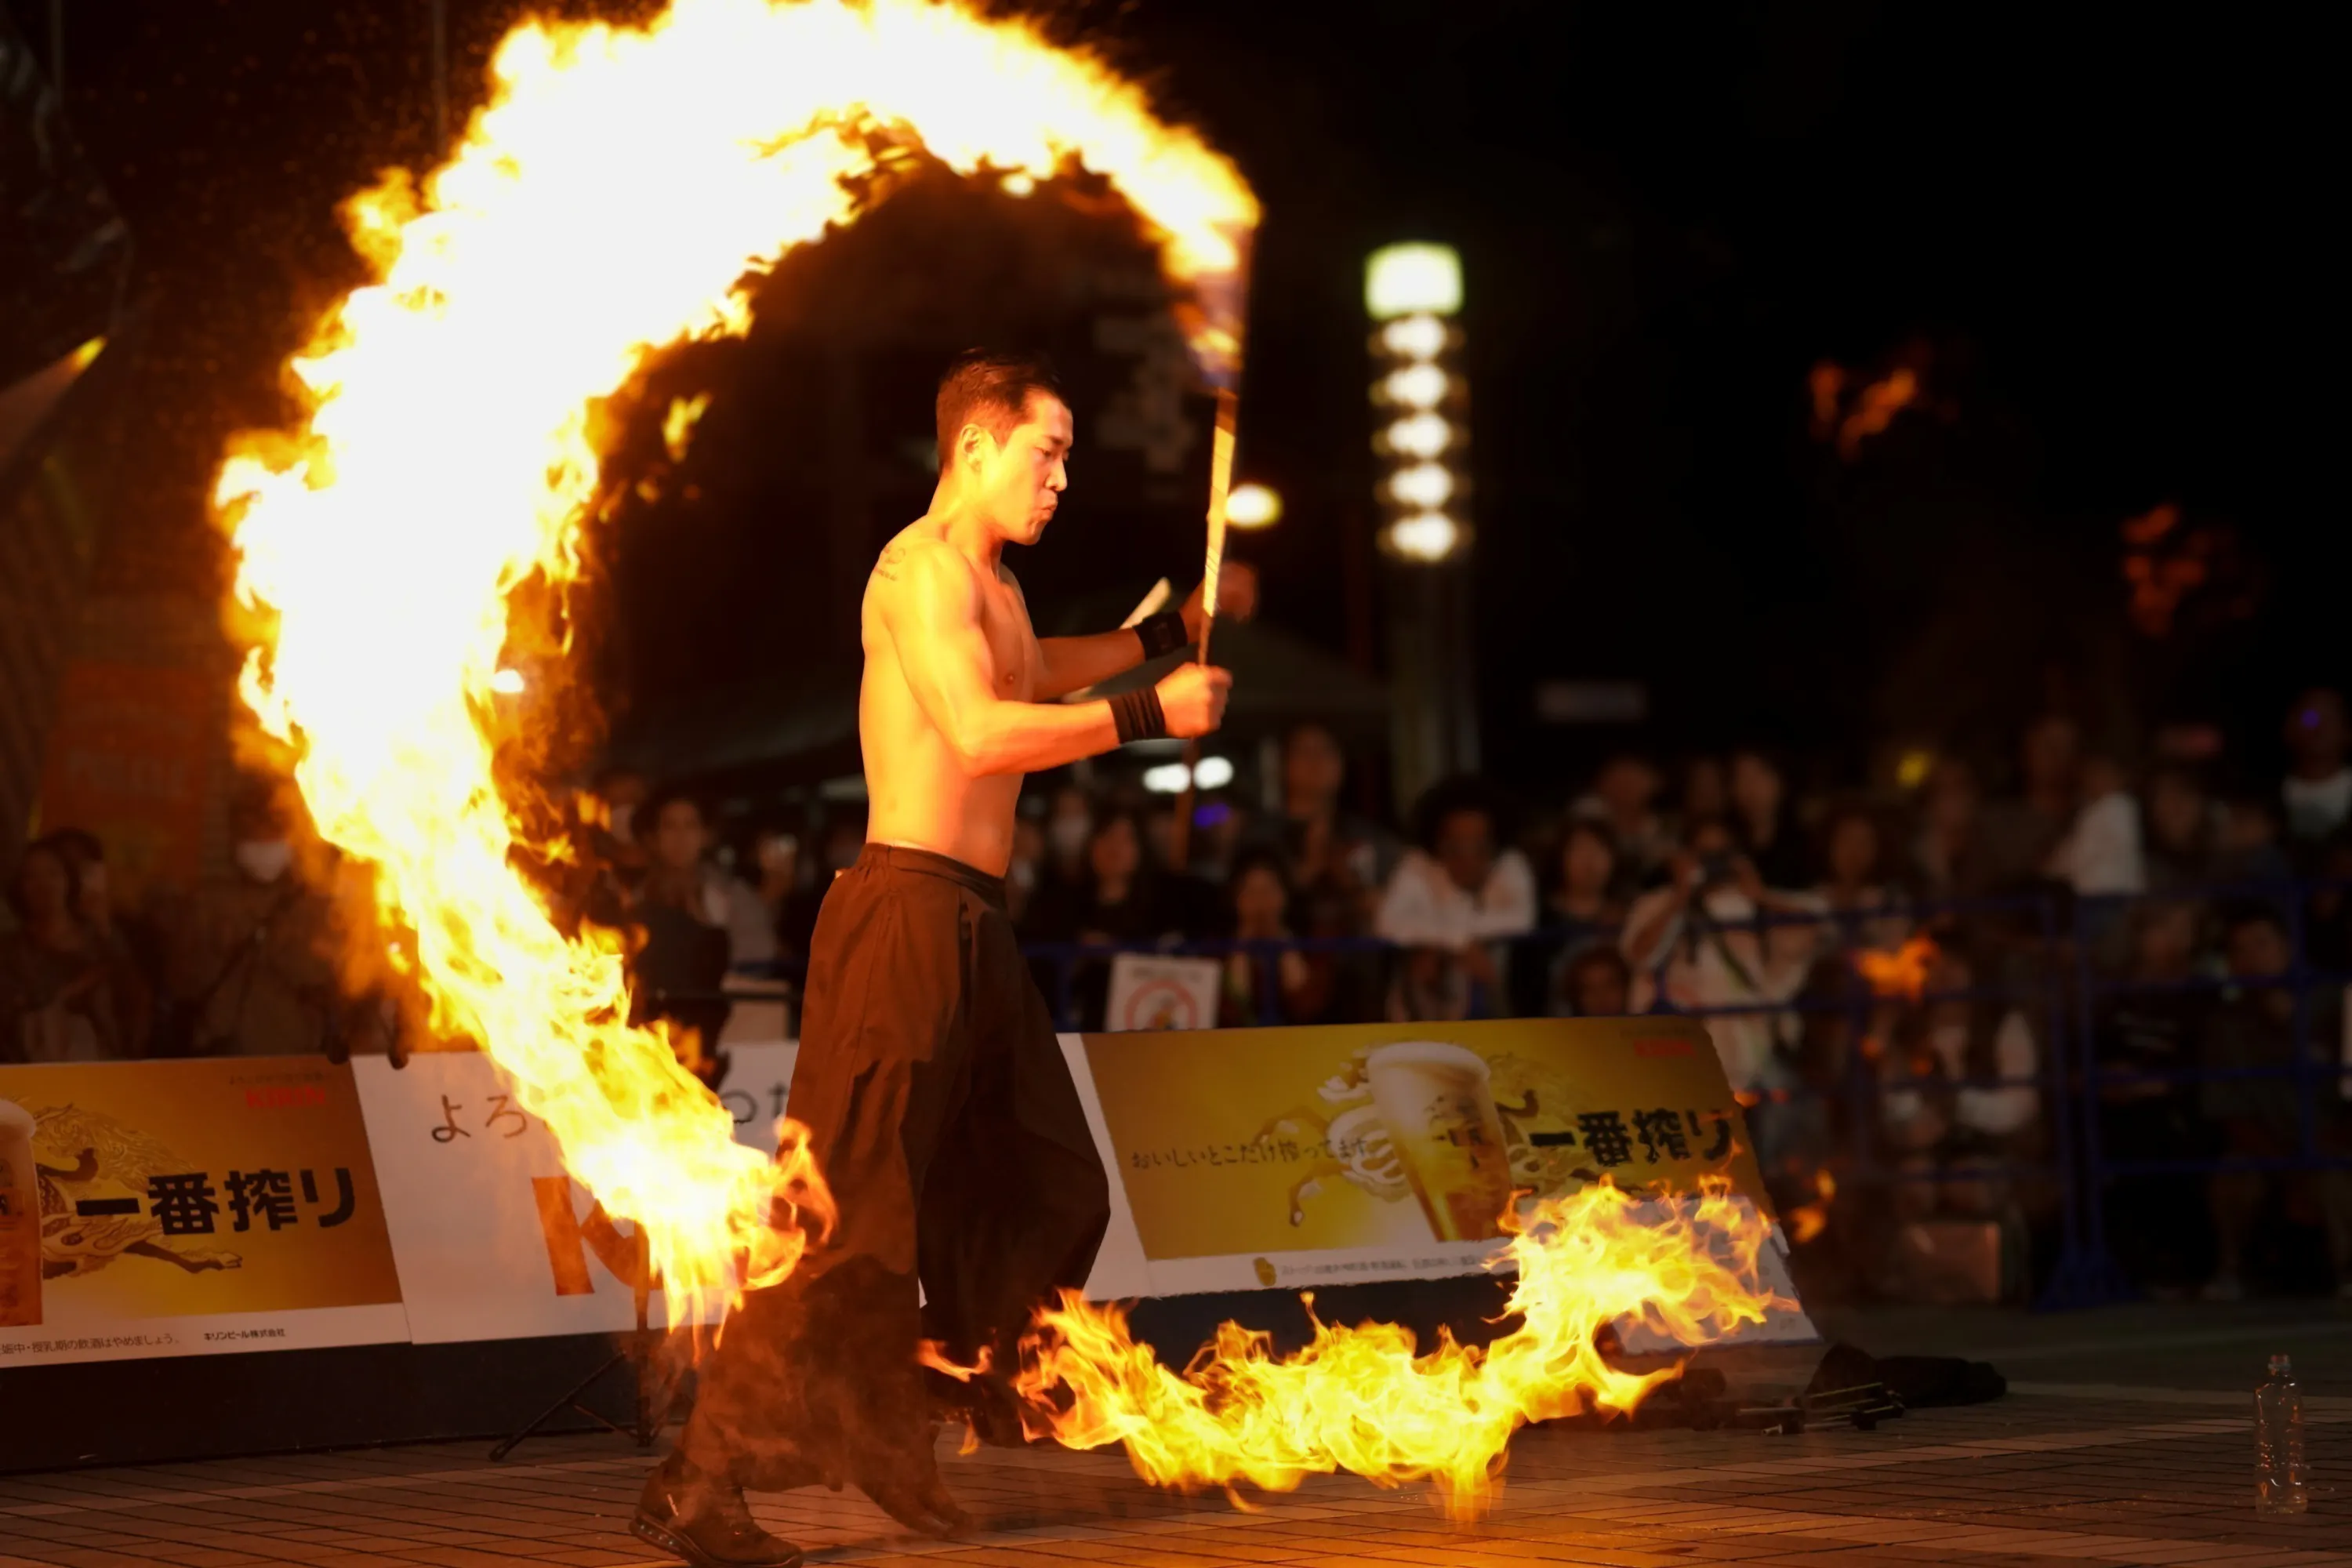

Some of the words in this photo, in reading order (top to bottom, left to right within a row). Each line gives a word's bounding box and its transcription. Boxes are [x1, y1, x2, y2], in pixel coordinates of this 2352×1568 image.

[1530, 1108, 1731, 1167] 一番搾り
[75, 1167, 356, 1236] 一番搾り
[0, 1333, 180, 1355] 娠中・授乳期の飲酒はやめましょう。
[203, 1328, 286, 1341] キリンビール株式会社
